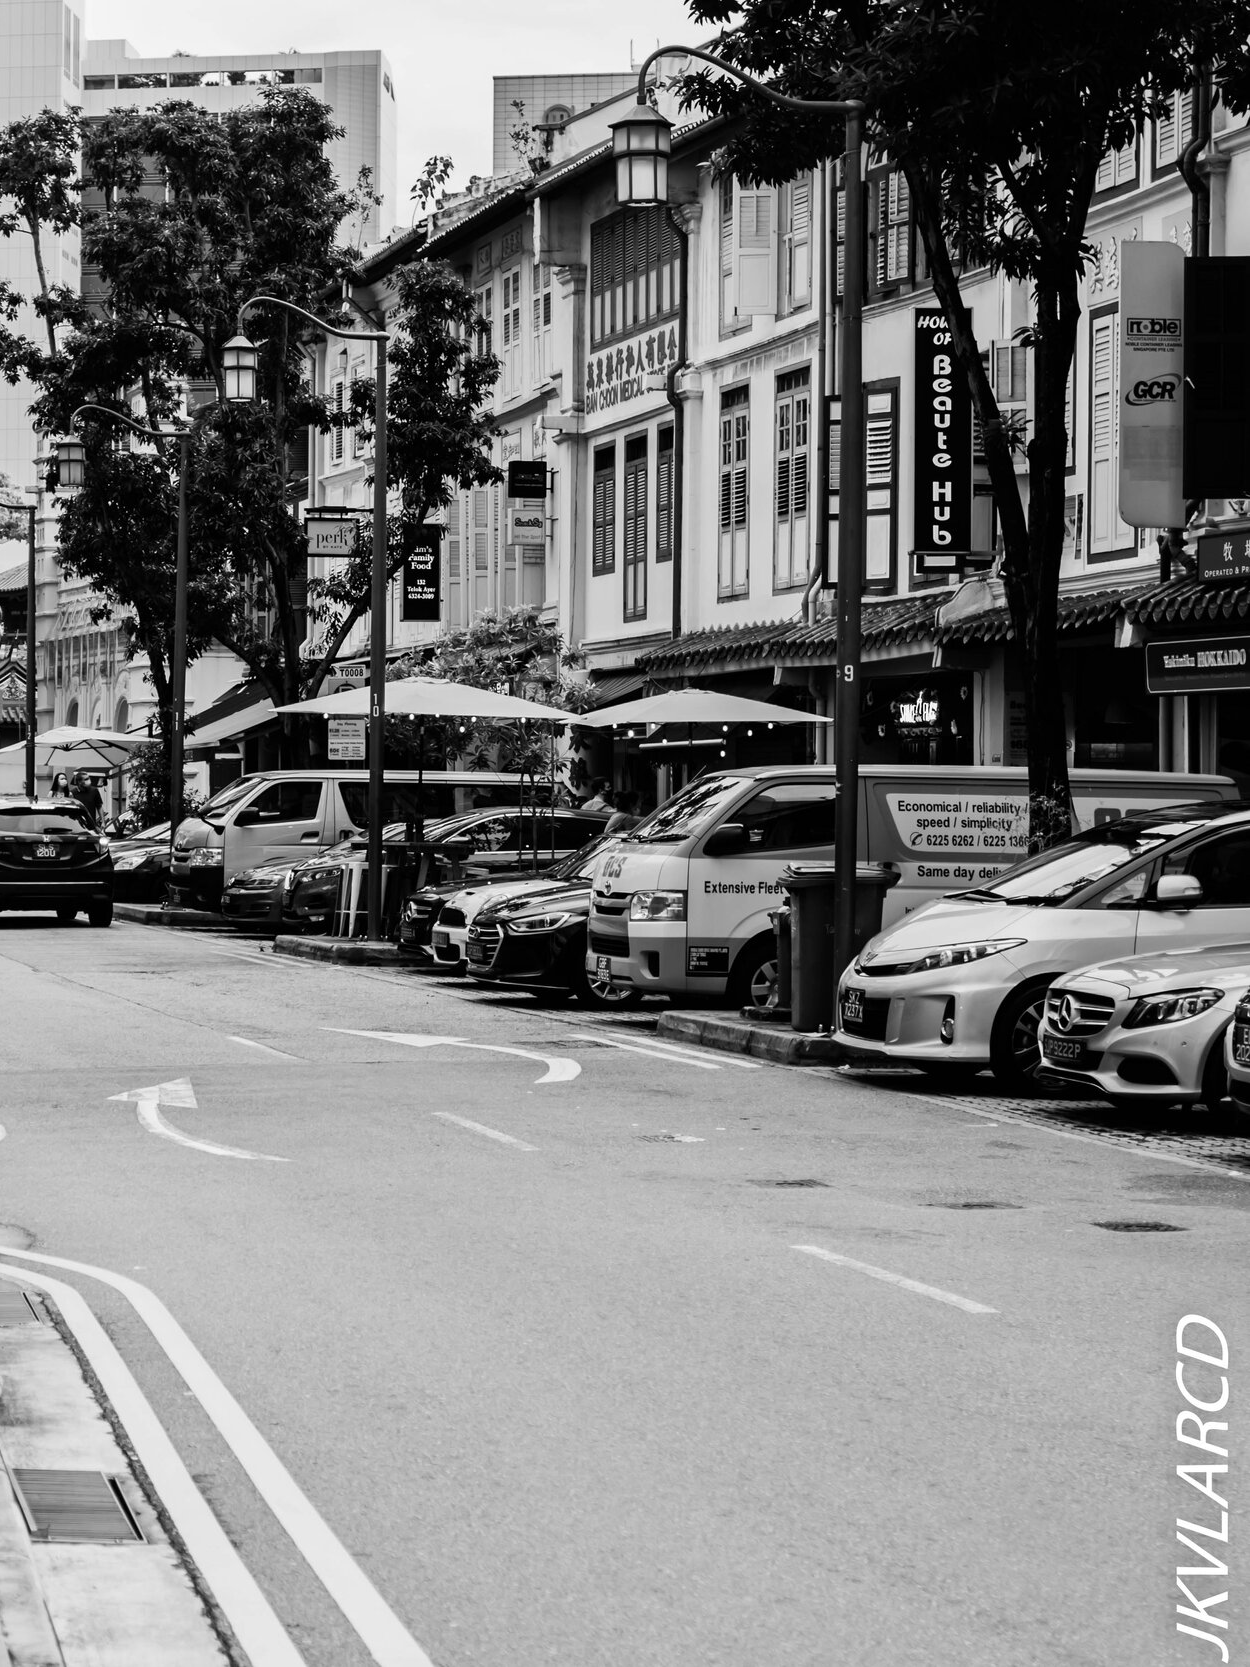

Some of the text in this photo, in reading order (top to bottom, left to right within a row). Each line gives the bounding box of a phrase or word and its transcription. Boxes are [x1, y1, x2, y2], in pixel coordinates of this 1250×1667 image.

[1129, 319, 1179, 335] noble
[933, 332, 952, 345] OF
[586, 374, 645, 415] BAN CHOON MEDICAL
[1133, 380, 1176, 400] GCR
[932, 354, 952, 468] Beaute
[932, 481, 952, 545] Hub
[413, 545, 432, 553] im's
[1204, 568, 1233, 578] OPERATED
[1197, 648, 1247, 668] HOKKAIDO
[340, 668, 364, 677] T0008
[844, 665, 853, 681] 9
[373, 693, 380, 717] 10
[898, 800, 961, 812] Economical
[972, 802, 1020, 816] reliability
[916, 817, 950, 830] speed
[961, 817, 1012, 831] simplicity
[926, 834, 949, 847] 6225
[952, 834, 974, 847] 6262
[983, 835, 1006, 847] 6225
[917, 865, 1001, 881] Same day deli
[704, 881, 784, 895] Extensive Fleet
